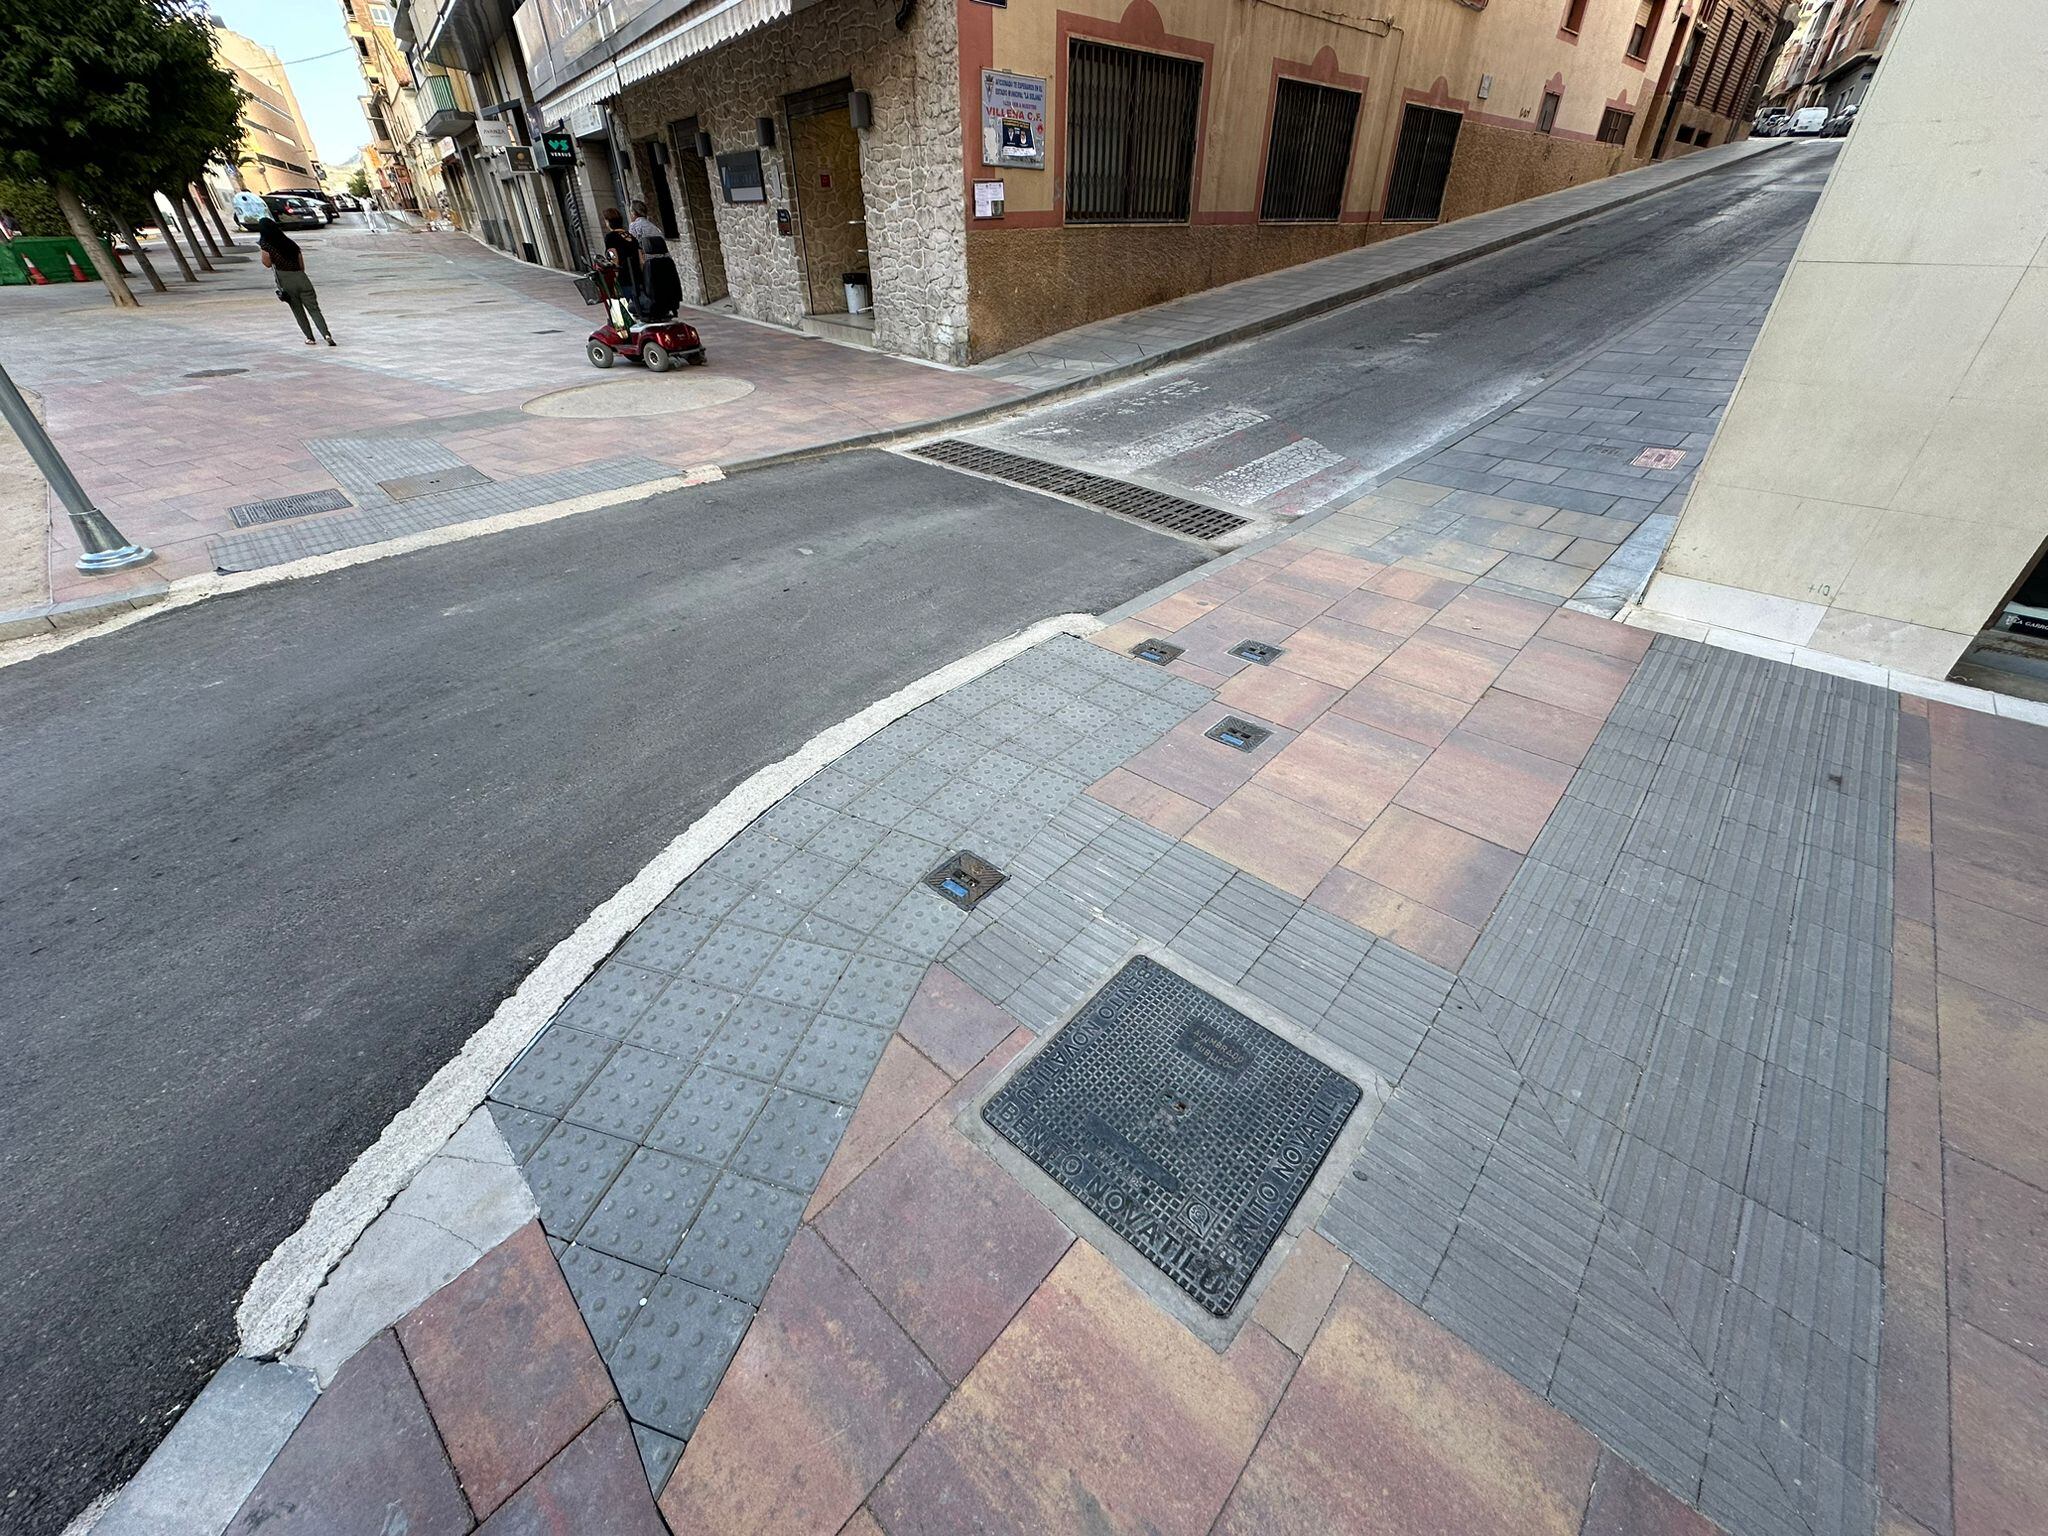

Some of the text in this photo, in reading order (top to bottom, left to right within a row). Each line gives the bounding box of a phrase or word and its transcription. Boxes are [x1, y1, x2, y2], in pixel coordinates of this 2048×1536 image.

[986, 106, 1024, 120] VILLENA
[1014, 968, 1153, 1101] BENITO NOVATILU
[1192, 1041, 1230, 1068] PUBLICO
[1193, 1028, 1244, 1064] ALUMBRADO
[1000, 1101, 1084, 1177] BENITO
[1085, 1174, 1225, 1295] NOVATILU
[1218, 1075, 1346, 1266] BENITO NOVATILU
